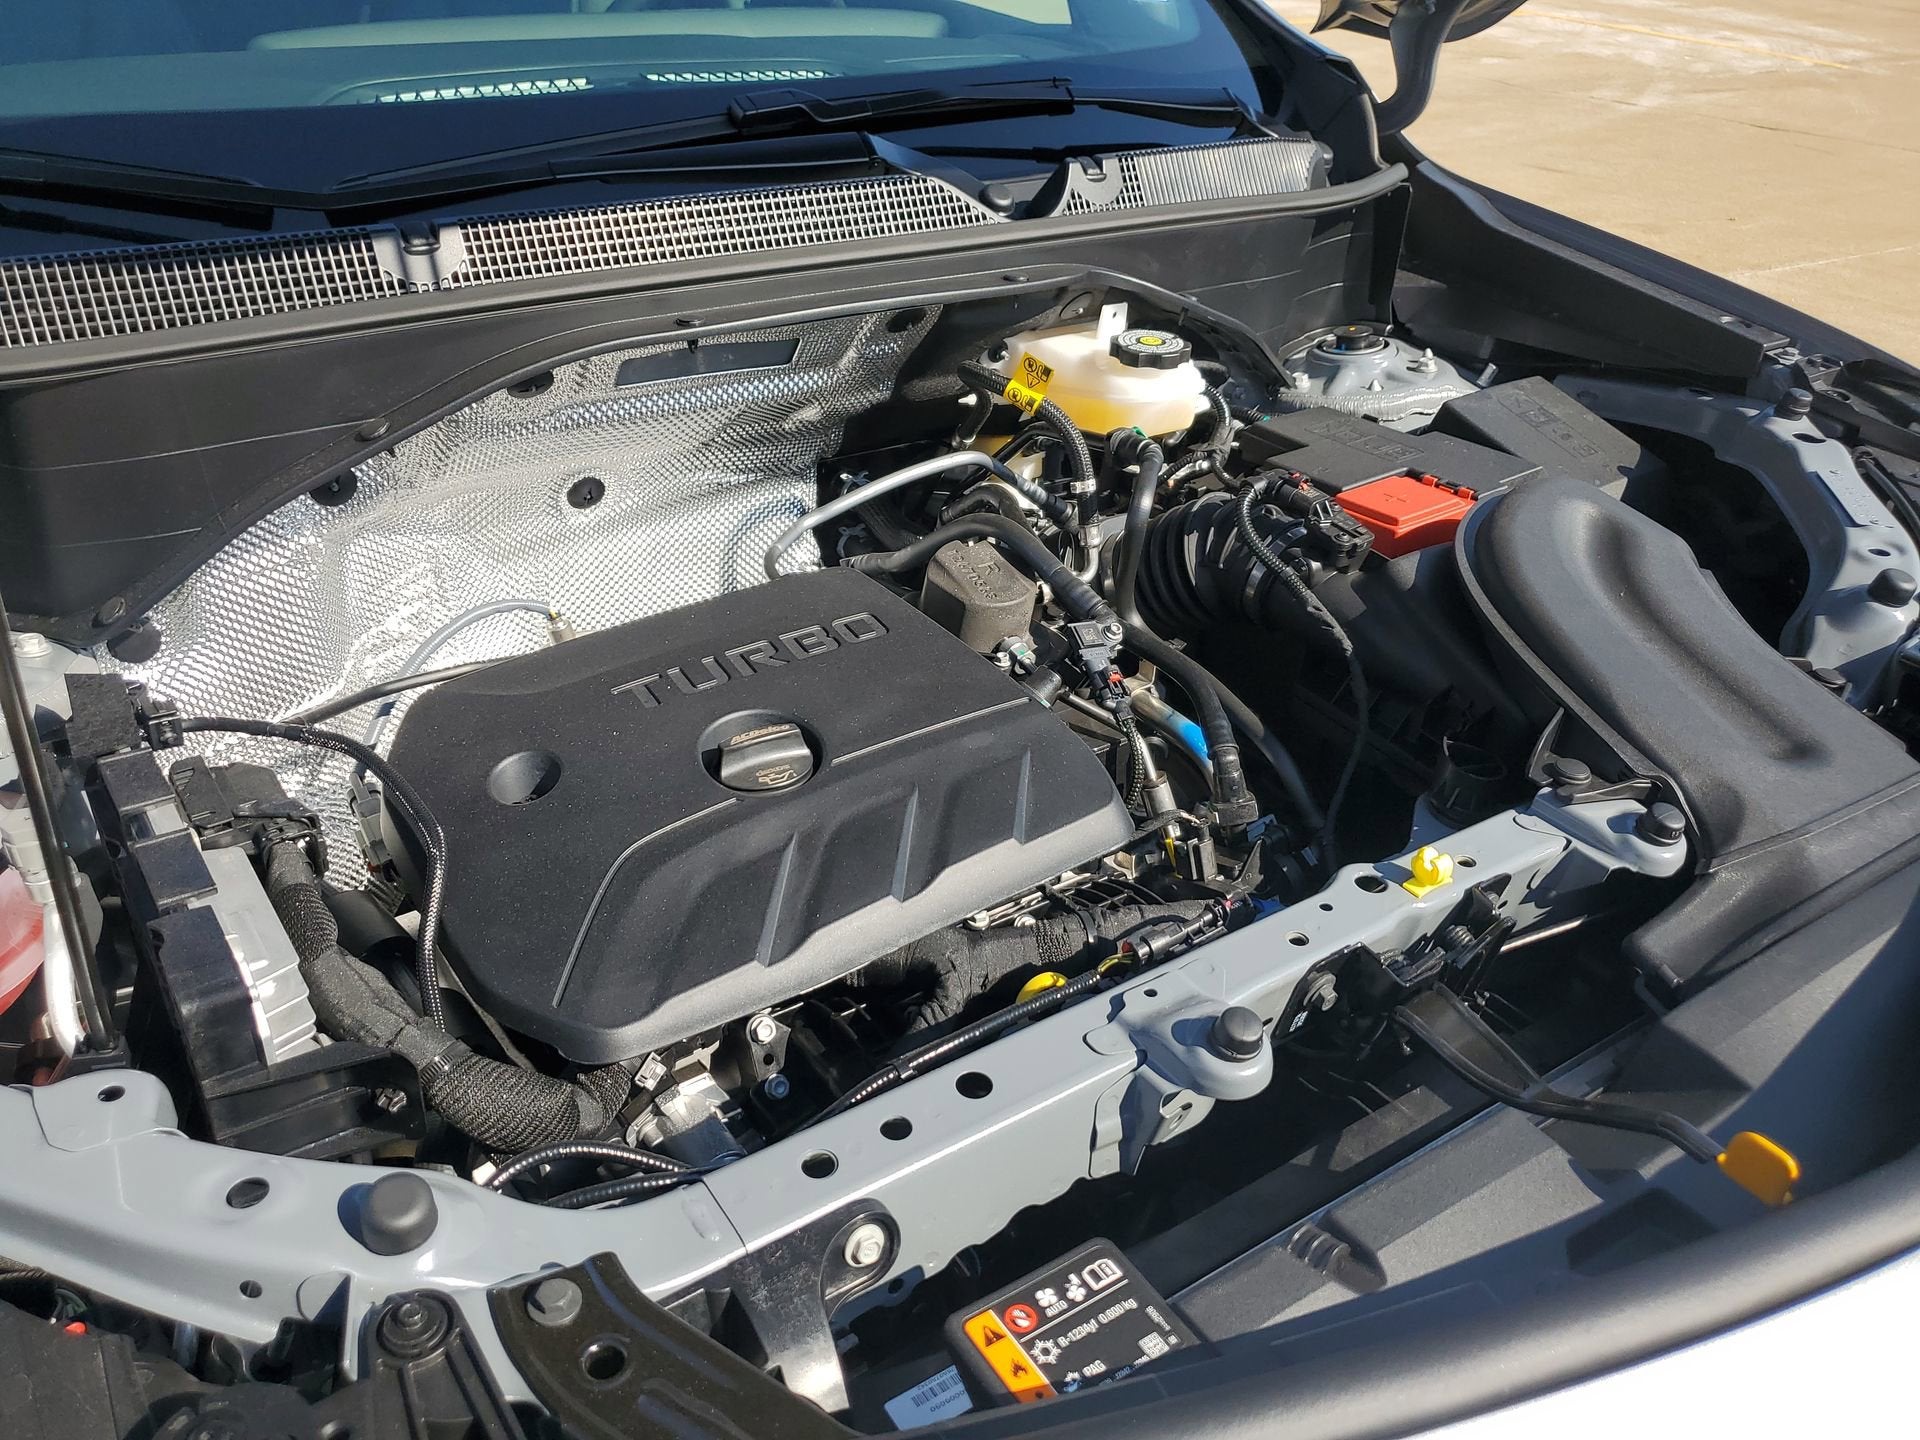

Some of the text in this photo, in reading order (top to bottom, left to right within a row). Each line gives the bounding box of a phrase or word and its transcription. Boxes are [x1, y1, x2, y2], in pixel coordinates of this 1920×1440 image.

[610, 612, 889, 709] TURBO
[730, 724, 791, 746] ACDelco
[1044, 1299, 1068, 1318] AUTO
[1056, 1318, 1099, 1348] R-1234yf
[1097, 1302, 1124, 1324] 0.600
[1122, 1298, 1138, 1311] kg
[1081, 1359, 1107, 1377] PAG
